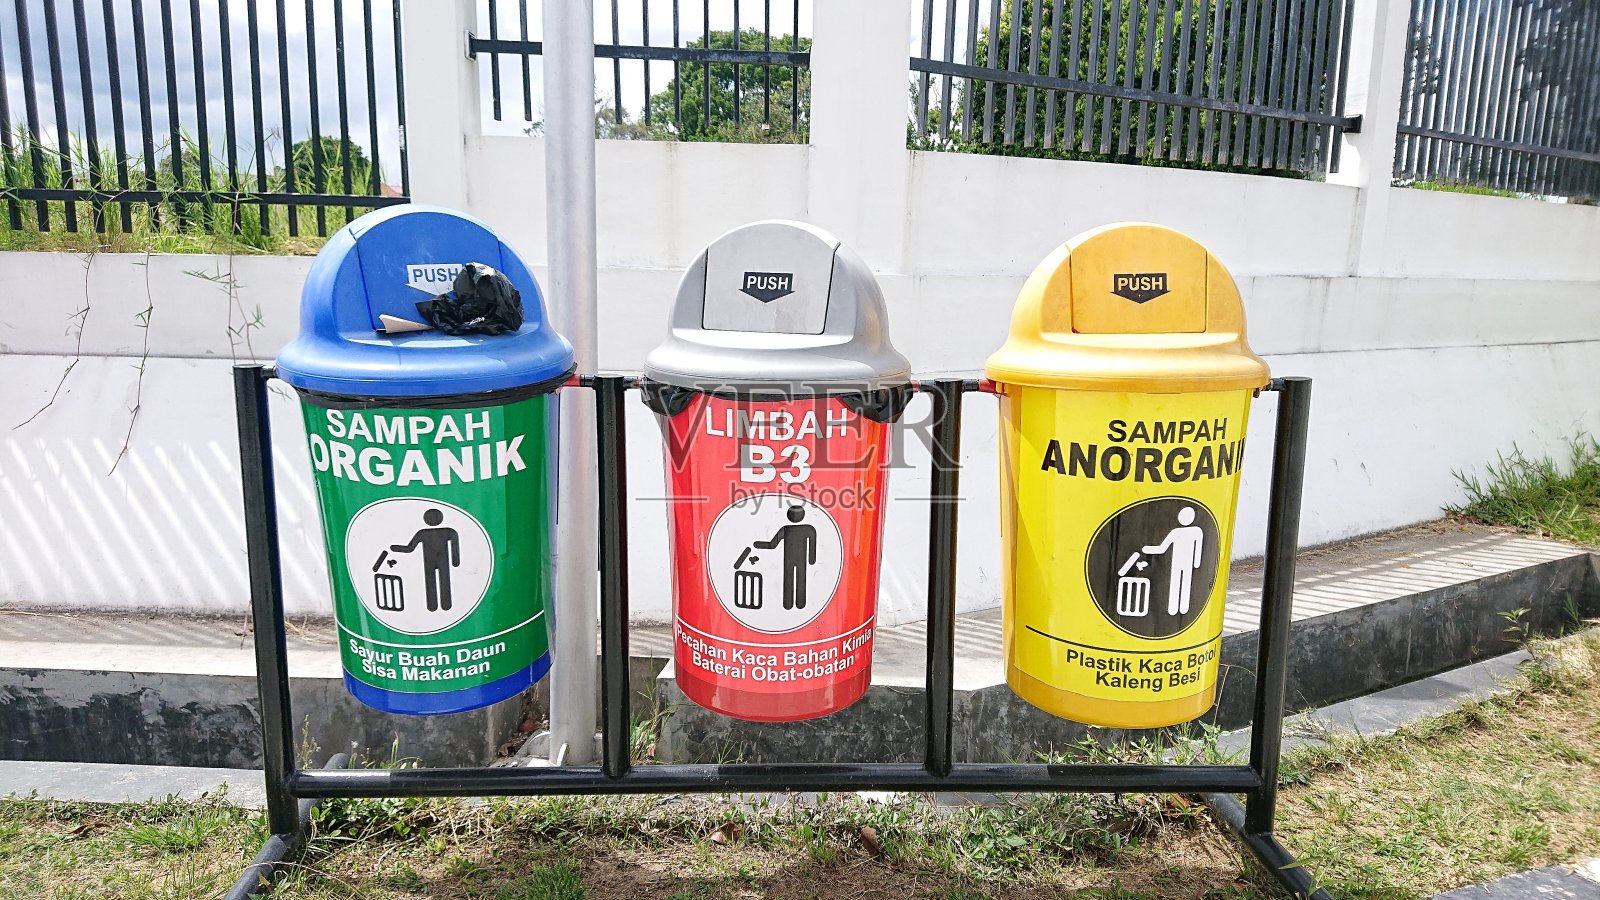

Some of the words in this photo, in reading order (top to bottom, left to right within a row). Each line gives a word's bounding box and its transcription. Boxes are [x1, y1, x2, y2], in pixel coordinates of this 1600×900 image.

[412, 267, 459, 283] PUSH
[746, 275, 789, 291] PUSH
[1117, 276, 1163, 291] PUSH
[326, 409, 491, 445] SAMPAH
[705, 405, 848, 442] LIMBAH
[1107, 417, 1228, 444] SAMPAH
[310, 433, 527, 487] ORGANIK
[739, 443, 813, 484] B3
[349, 638, 393, 665] Sayur
[398, 651, 450, 667] Buah
[456, 641, 506, 663] Daun
[676, 622, 727, 661] Pecahan
[731, 647, 778, 667] Kaca
[783, 643, 838, 667] Bahan
[841, 627, 873, 653] Kimia
[1066, 649, 1132, 673] Plastik
[1138, 658, 1183, 674] Kaca
[1187, 643, 1218, 669] Botol
[362, 658, 397, 680] Sisa
[402, 660, 491, 681] Makanan
[692, 651, 746, 680] Baterai
[751, 653, 855, 682] Obat-obatan
[1095, 671, 1163, 693] Kaleng
[1168, 667, 1201, 688] Besi
